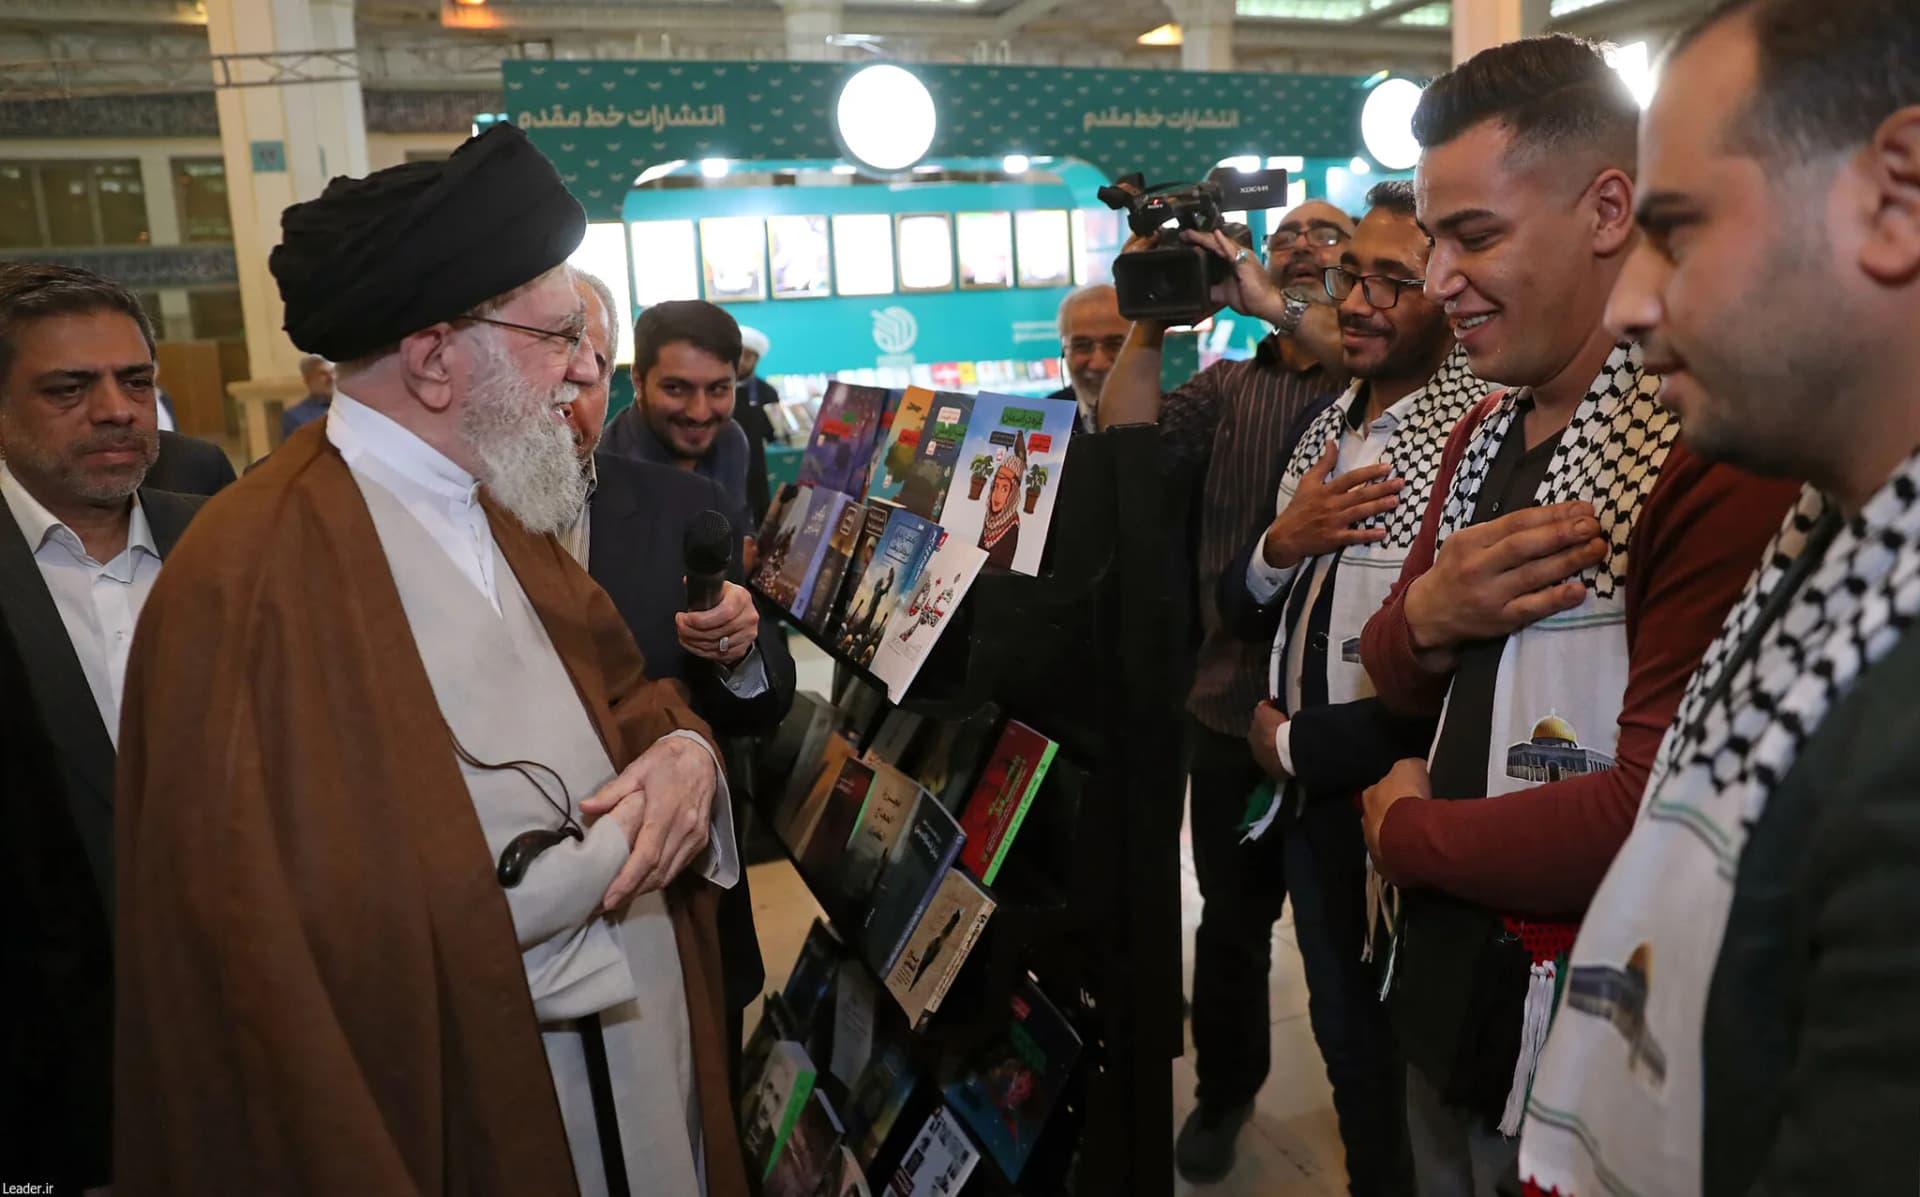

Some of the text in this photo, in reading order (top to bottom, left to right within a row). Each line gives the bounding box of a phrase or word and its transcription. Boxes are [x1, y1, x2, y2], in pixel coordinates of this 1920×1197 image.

[518, 103, 725, 133] انتشارات خط مقدم
[1083, 106, 1240, 133] انتشارات خط مقدم
